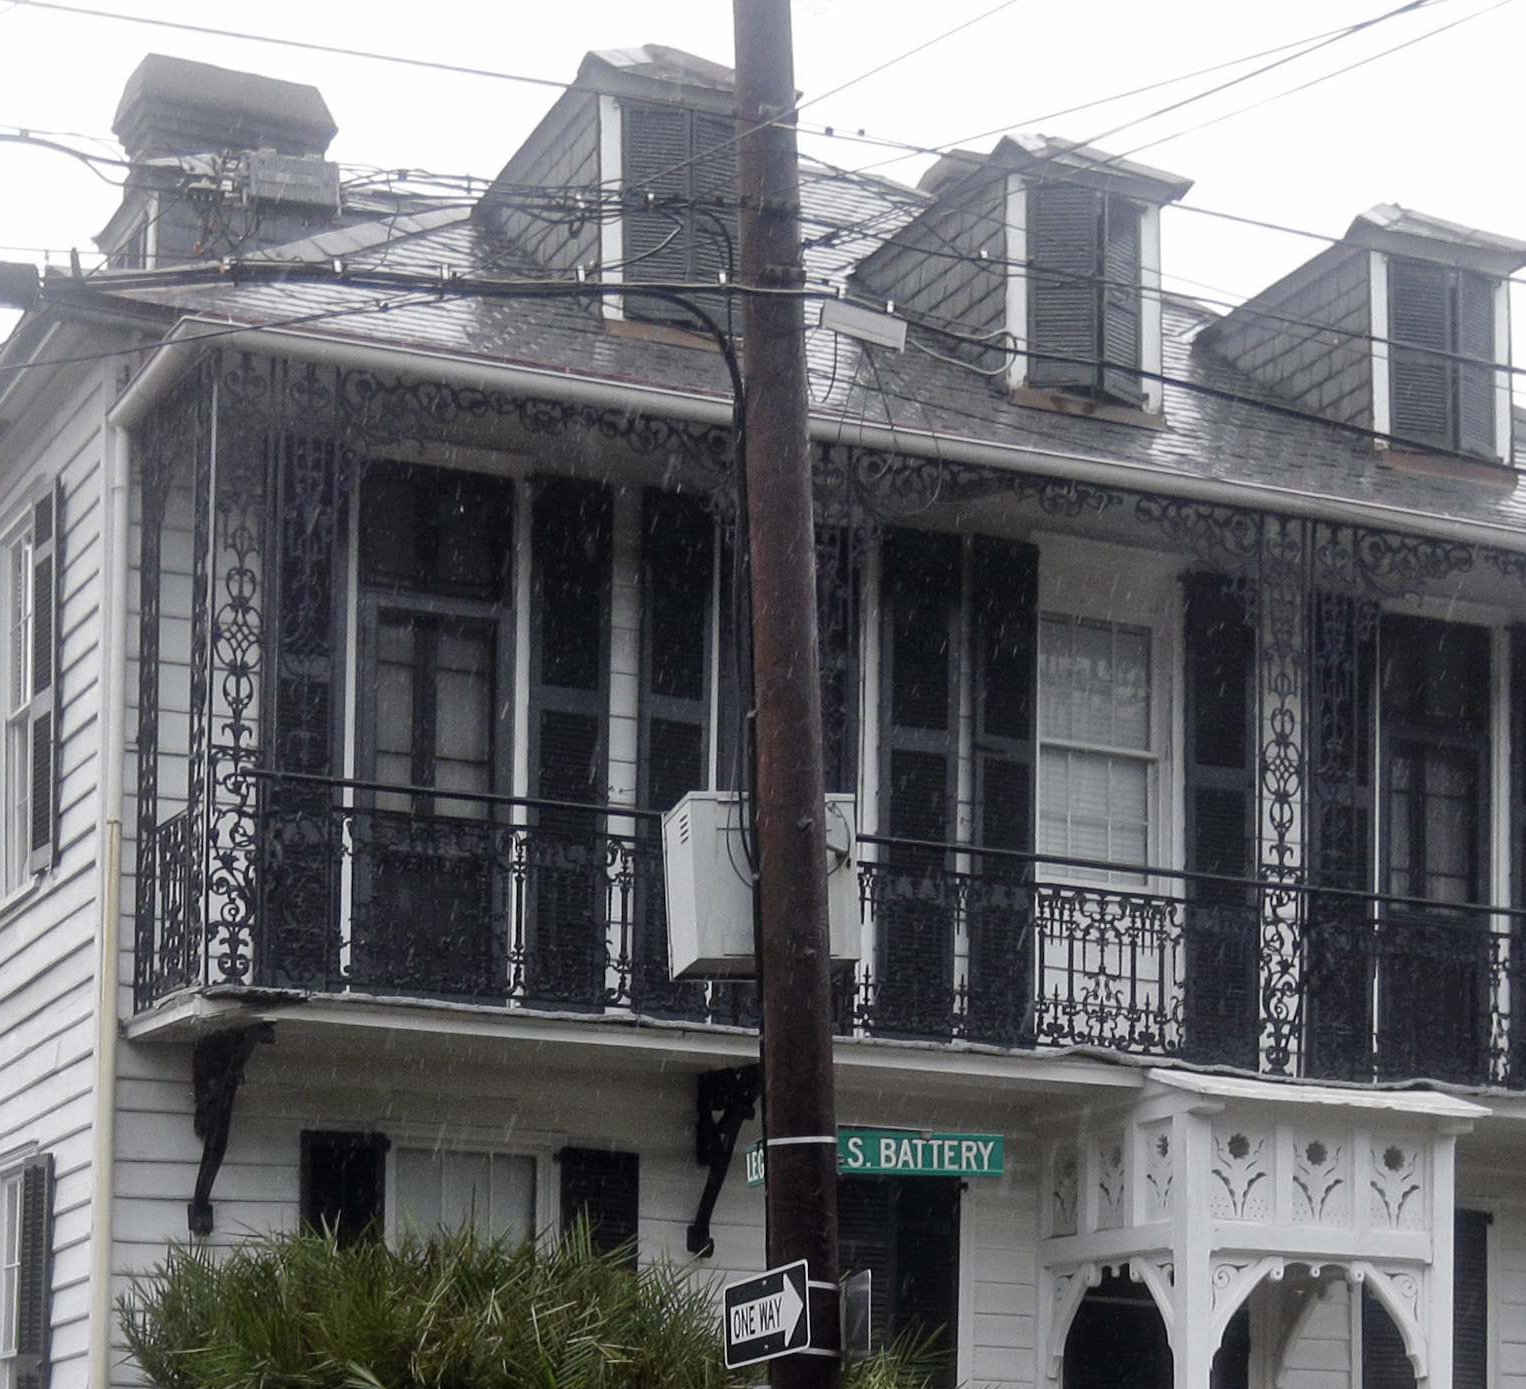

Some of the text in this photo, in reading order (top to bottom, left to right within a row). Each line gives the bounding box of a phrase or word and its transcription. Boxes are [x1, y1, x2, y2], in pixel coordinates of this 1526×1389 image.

[746, 1148, 765, 1183] LEG
[848, 1137, 995, 1171] S. BATTERY
[734, 1295, 783, 1339] ONE WAY
